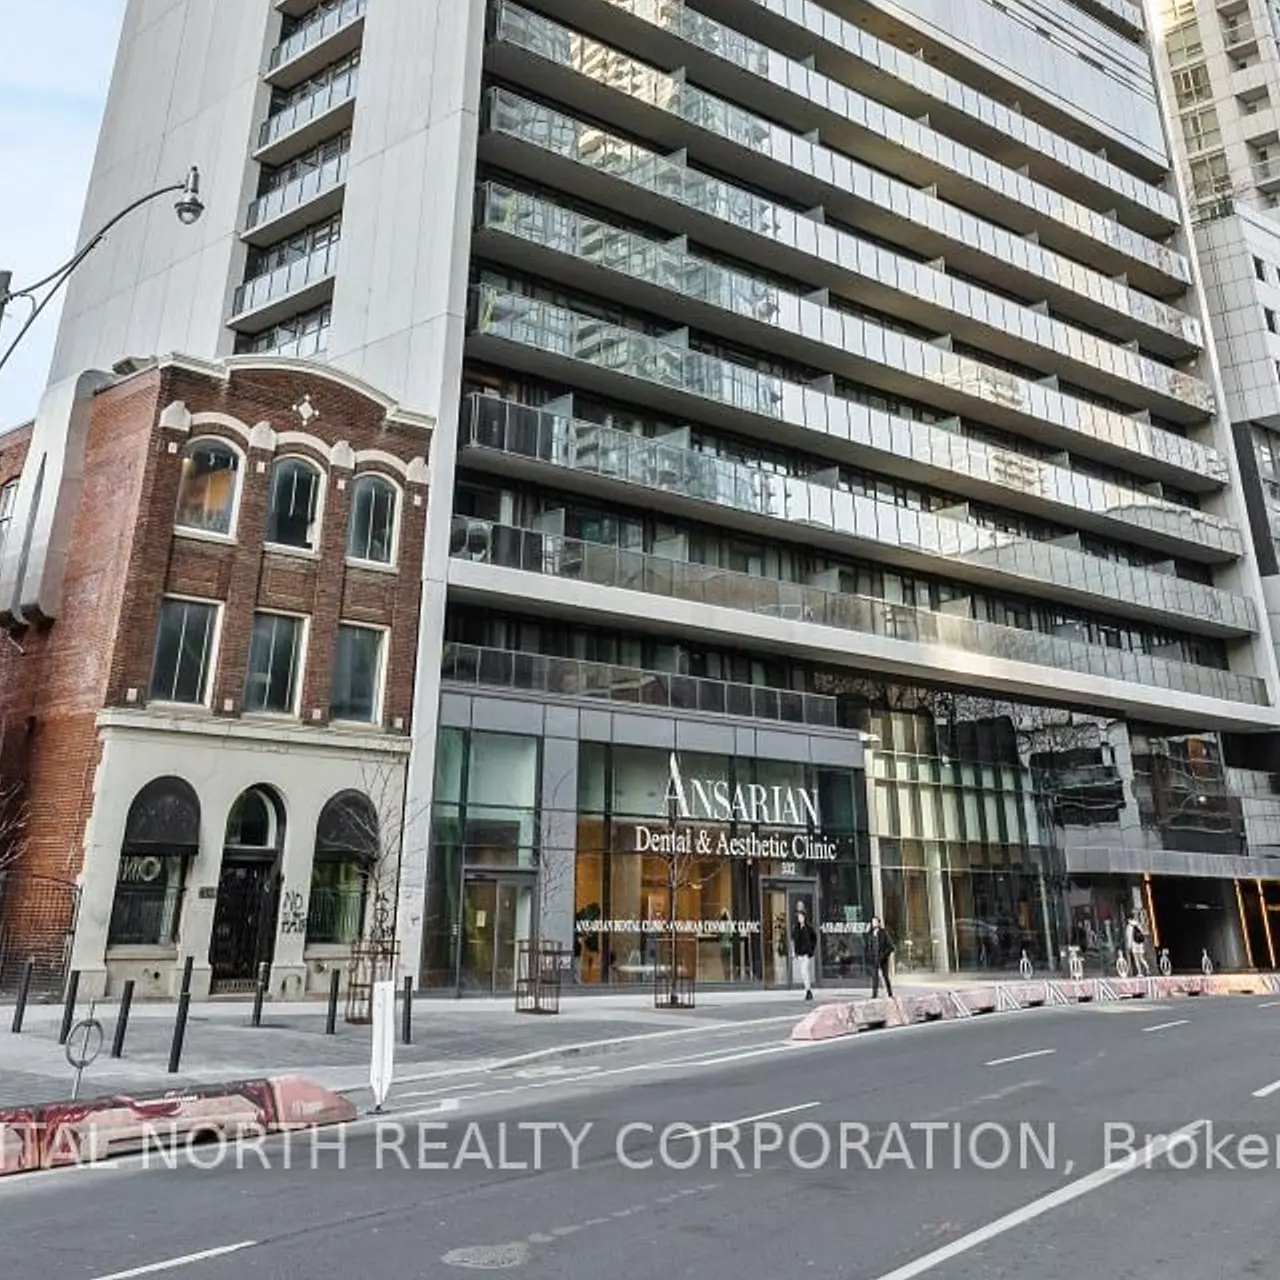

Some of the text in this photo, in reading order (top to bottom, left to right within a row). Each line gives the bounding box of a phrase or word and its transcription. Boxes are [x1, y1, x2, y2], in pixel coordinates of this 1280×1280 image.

[658, 751, 819, 826] ANSARIAN
[634, 825, 838, 860] Dental & Aesthetic Clinic
